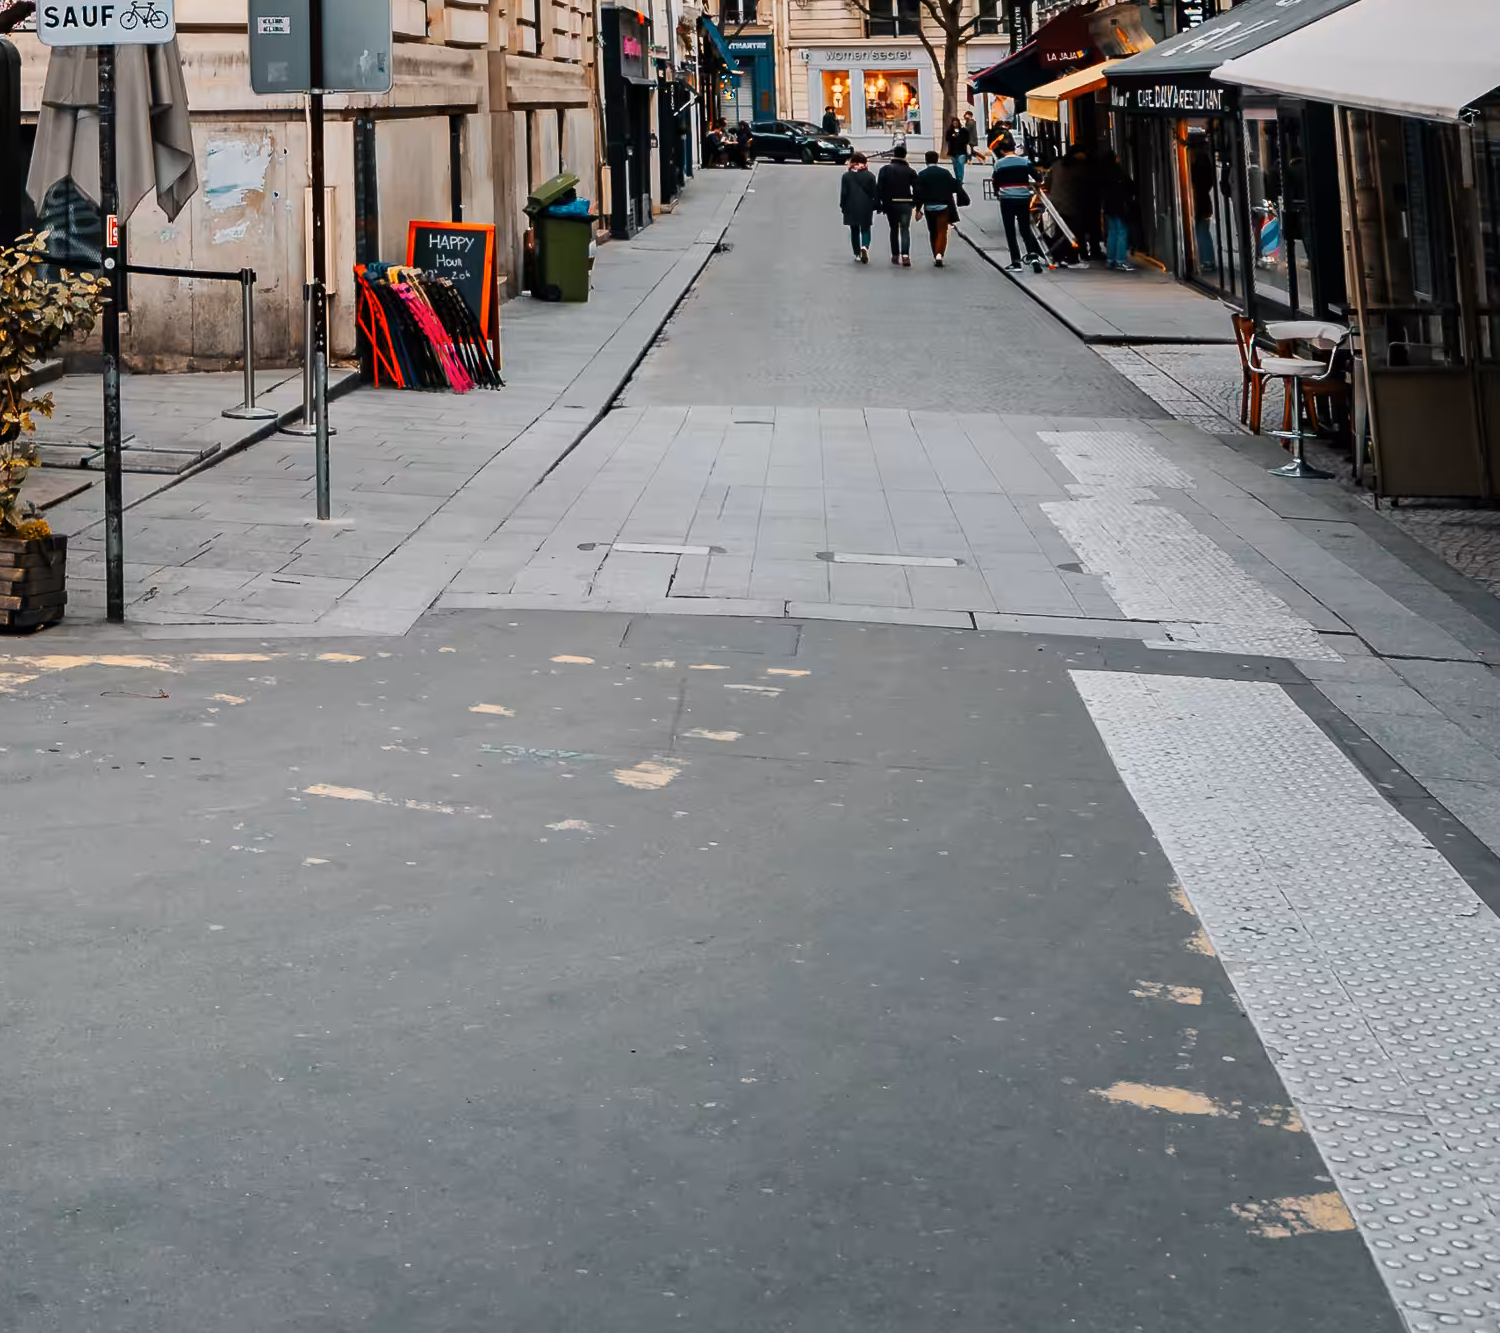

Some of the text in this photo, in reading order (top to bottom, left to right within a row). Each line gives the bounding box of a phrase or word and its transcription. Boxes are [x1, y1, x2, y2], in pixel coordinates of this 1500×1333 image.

[43, 4, 115, 29] SAUF
[825, 49, 912, 61] women'secret
[429, 233, 474, 252] HAPPY
